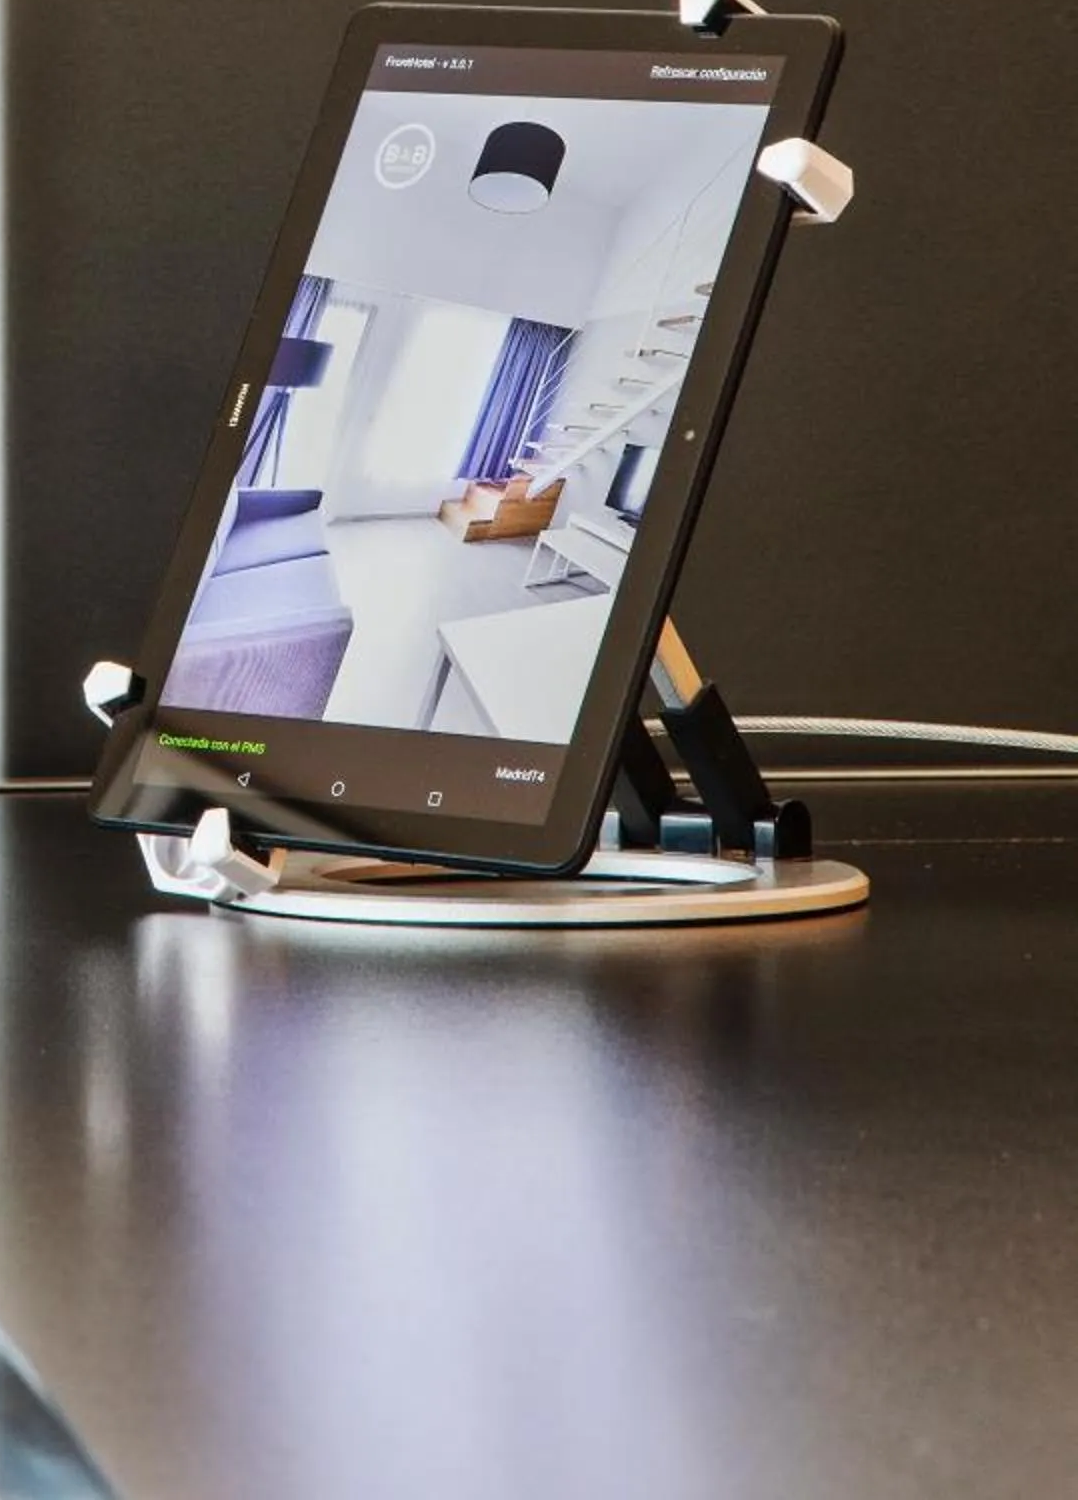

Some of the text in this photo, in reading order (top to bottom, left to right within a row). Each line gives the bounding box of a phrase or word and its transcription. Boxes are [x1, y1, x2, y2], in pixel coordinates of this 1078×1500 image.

[650, 64, 768, 82] Refrescar configuración
[228, 382, 251, 428] HUAWEI
[211, 740, 230, 751] con
[230, 740, 241, 753] el
[242, 740, 267, 756] PMS
